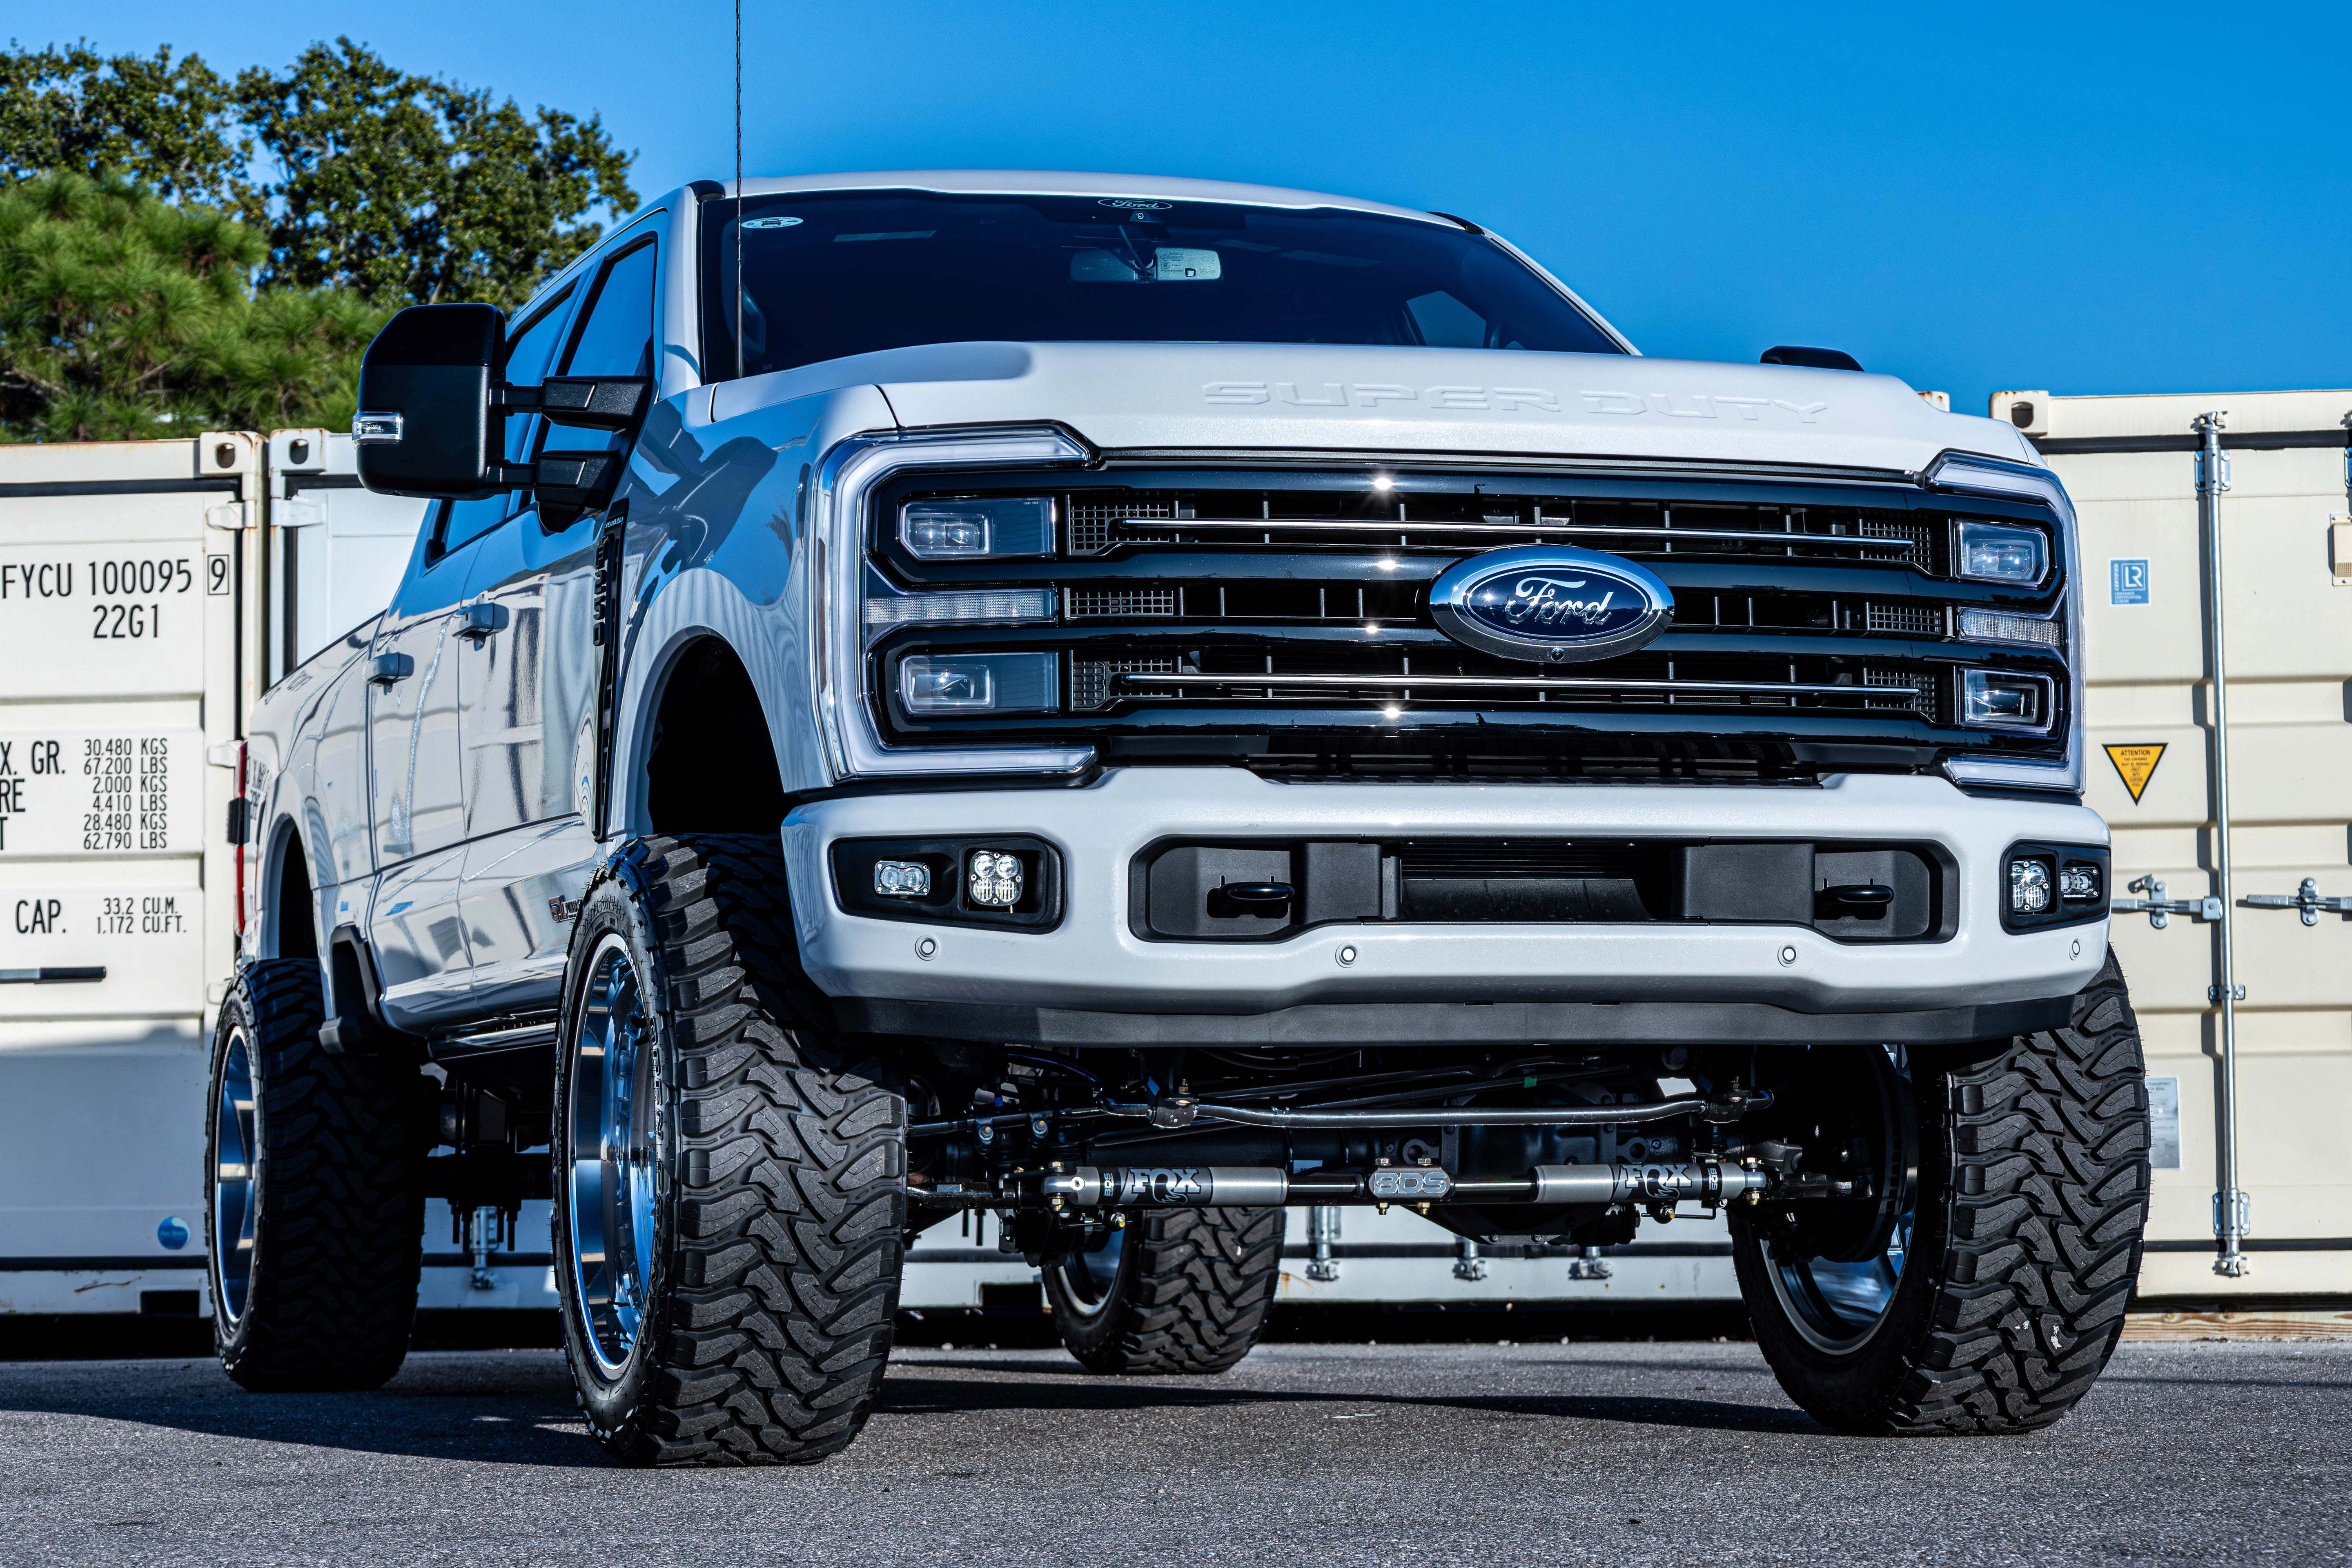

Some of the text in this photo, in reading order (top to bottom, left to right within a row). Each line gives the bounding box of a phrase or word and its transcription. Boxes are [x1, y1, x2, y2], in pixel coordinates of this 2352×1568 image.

[1112, 199, 1159, 208] Ford
[1201, 381, 1827, 423] SUPER DUTY
[2, 558, 226, 599] FYCU 100095 9
[2125, 566, 2143, 587] LR
[1505, 577, 1614, 625] Ford
[92, 604, 159, 639] 22G1
[31, 740, 66, 775] GR.
[140, 738, 167, 755] KGS
[140, 757, 167, 774] LBS
[140, 775, 167, 793] KGS
[140, 794, 167, 811] LBS
[140, 813, 167, 830] KGS
[140, 831, 167, 849] LBS
[15, 899, 67, 934] CAP.
[103, 897, 134, 915] 33.2
[1128, 1168, 1201, 1204] FOX
[1373, 1172, 1448, 1194] BDS
[1621, 1164, 1693, 1199] FOX
[1710, 1168, 1718, 1191] BDS
